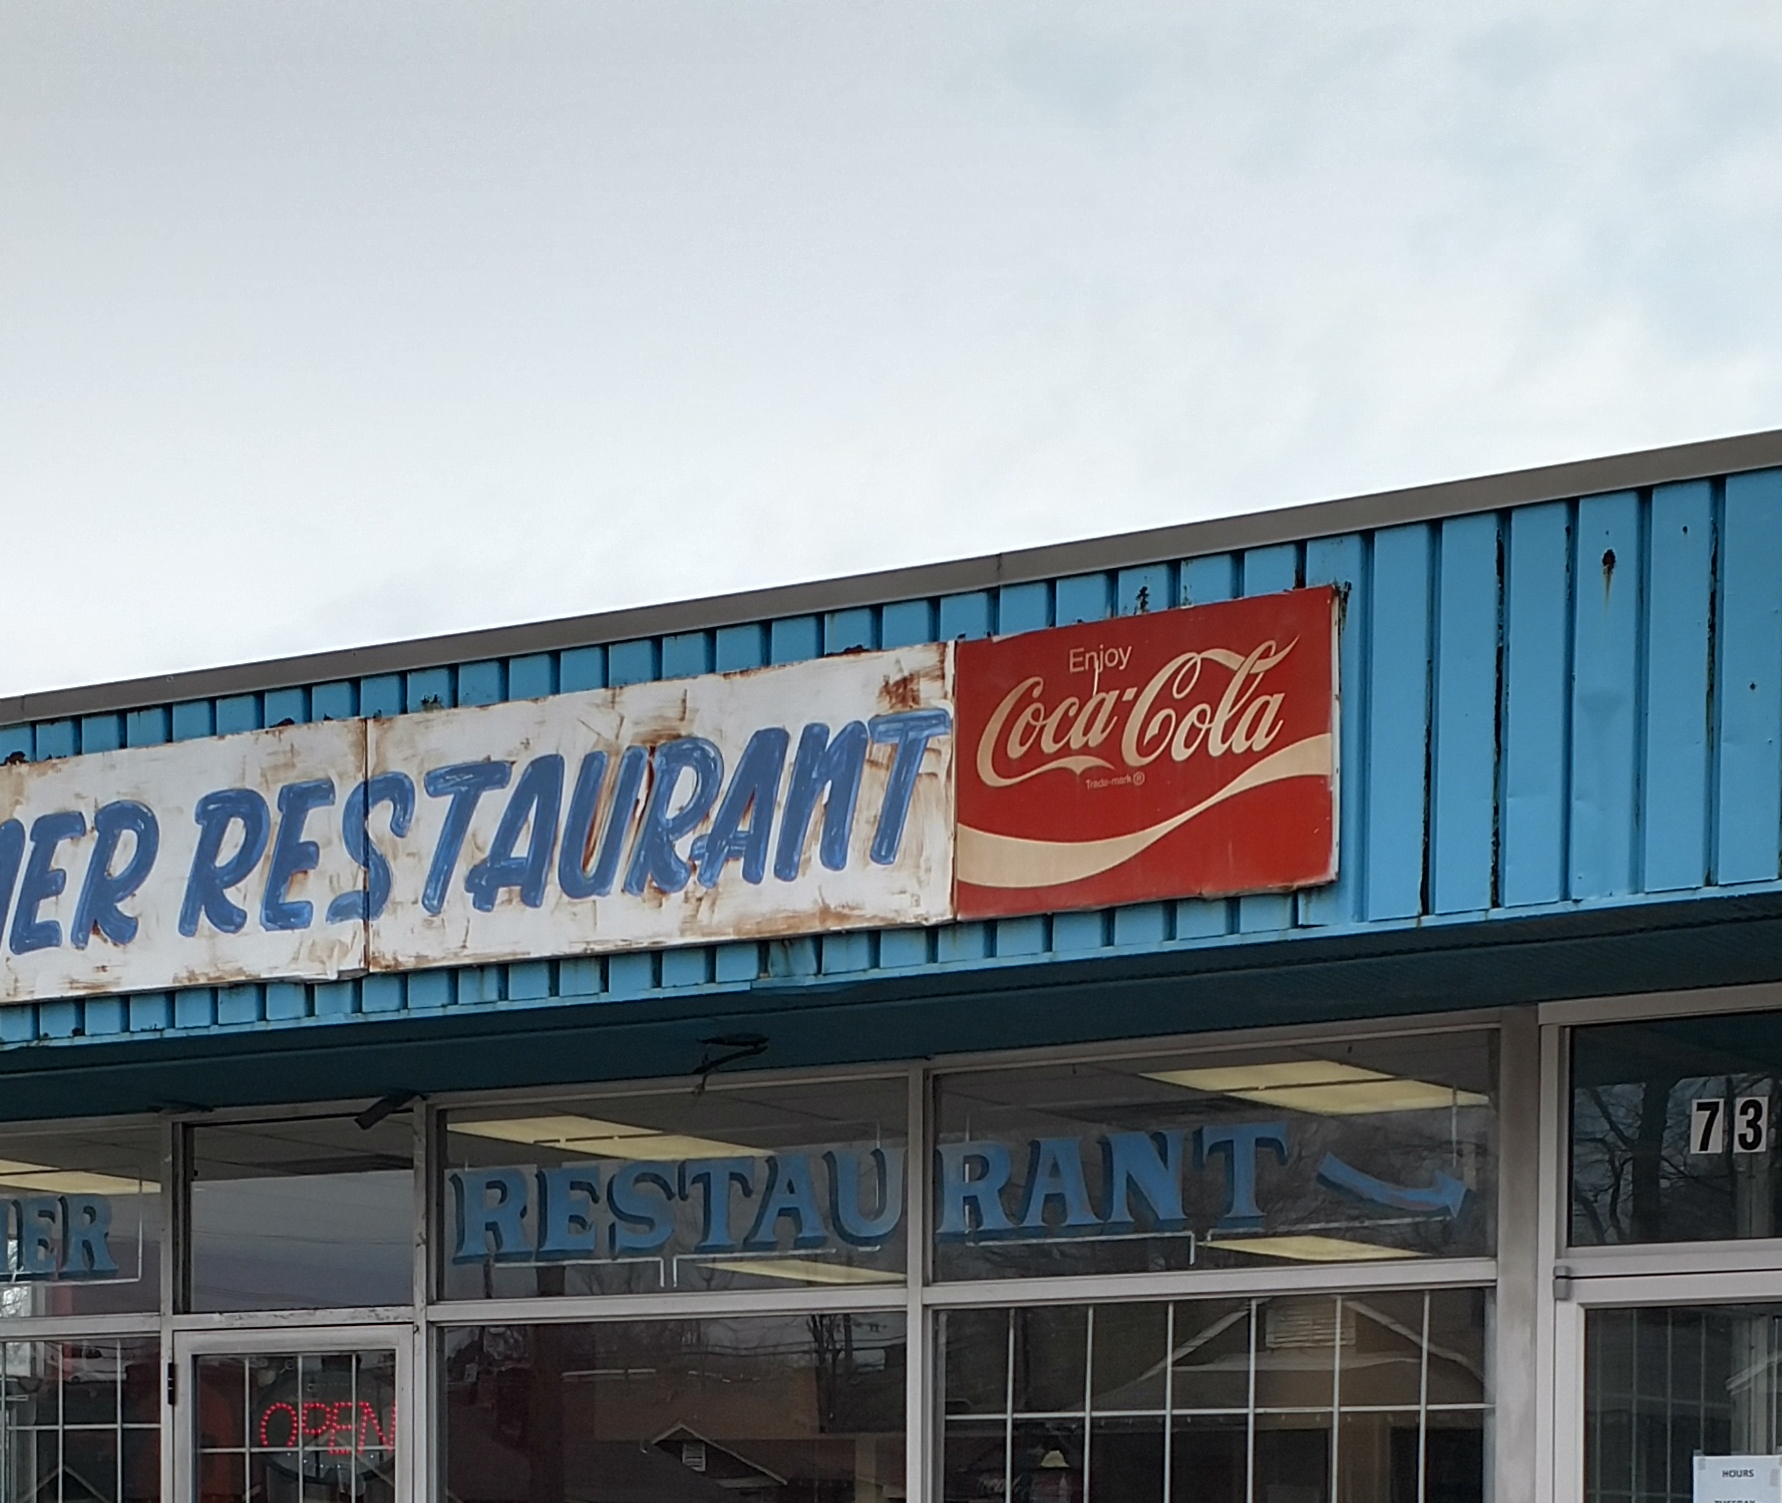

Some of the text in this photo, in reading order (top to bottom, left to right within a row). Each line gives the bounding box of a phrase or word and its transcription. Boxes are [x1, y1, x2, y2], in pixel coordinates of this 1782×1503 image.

[1069, 644, 1132, 674] Enjoy
[976, 634, 1300, 787] Coca-Cola
[177, 706, 952, 938] RESTAURANT
[260, 1399, 397, 1456] OPEN
[1722, 1469, 1755, 1478] HOURS
